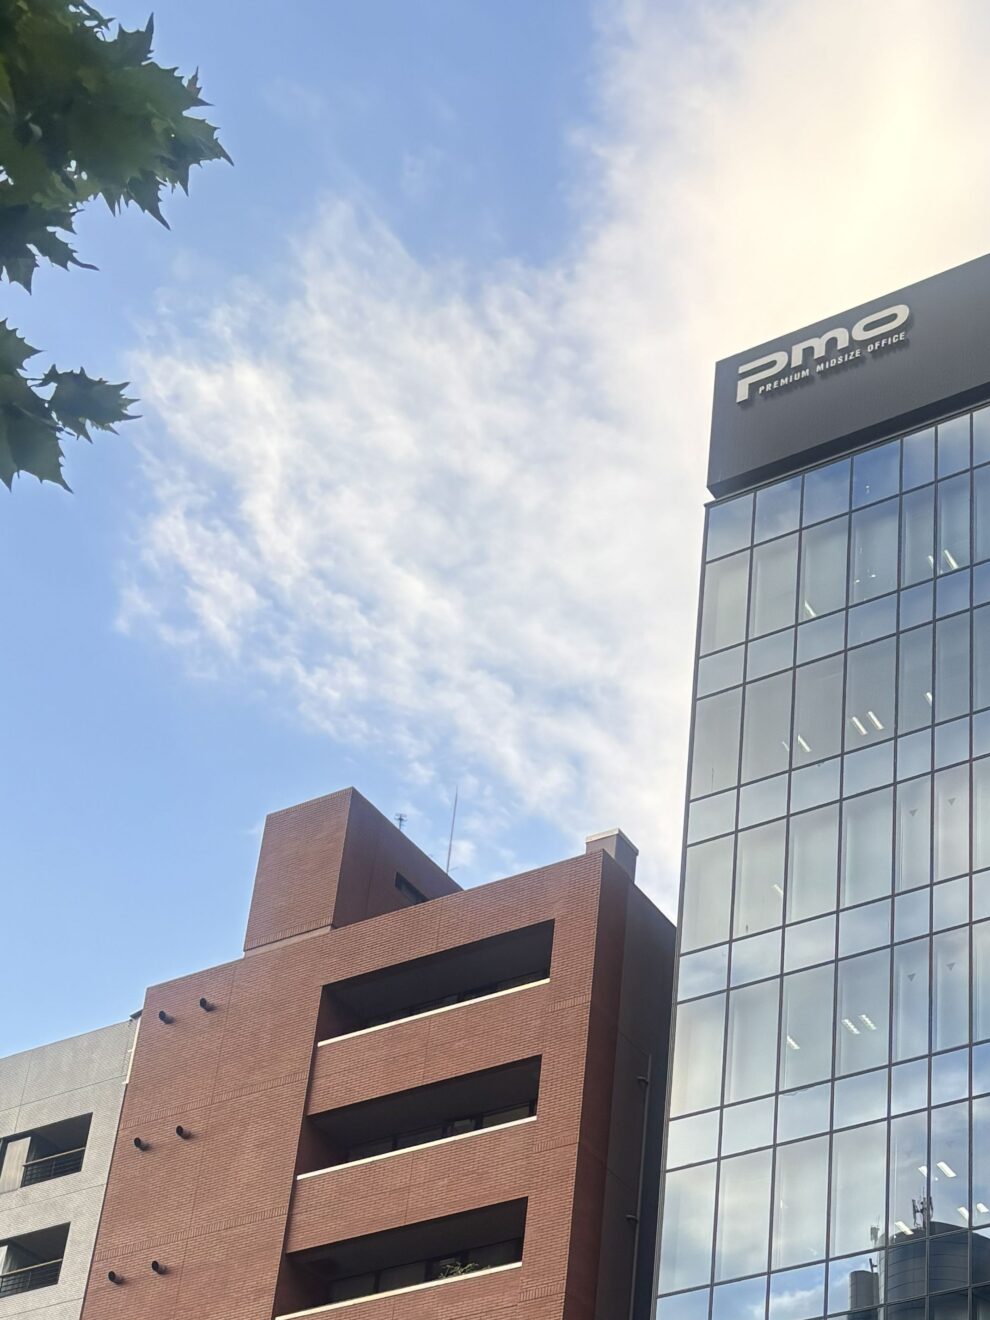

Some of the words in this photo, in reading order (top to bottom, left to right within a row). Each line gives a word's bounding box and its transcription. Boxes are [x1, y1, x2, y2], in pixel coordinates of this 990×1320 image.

[758, 368, 810, 394] PREMIUM
[815, 348, 862, 373] MIDSIZE
[866, 331, 906, 353] OFFICE
